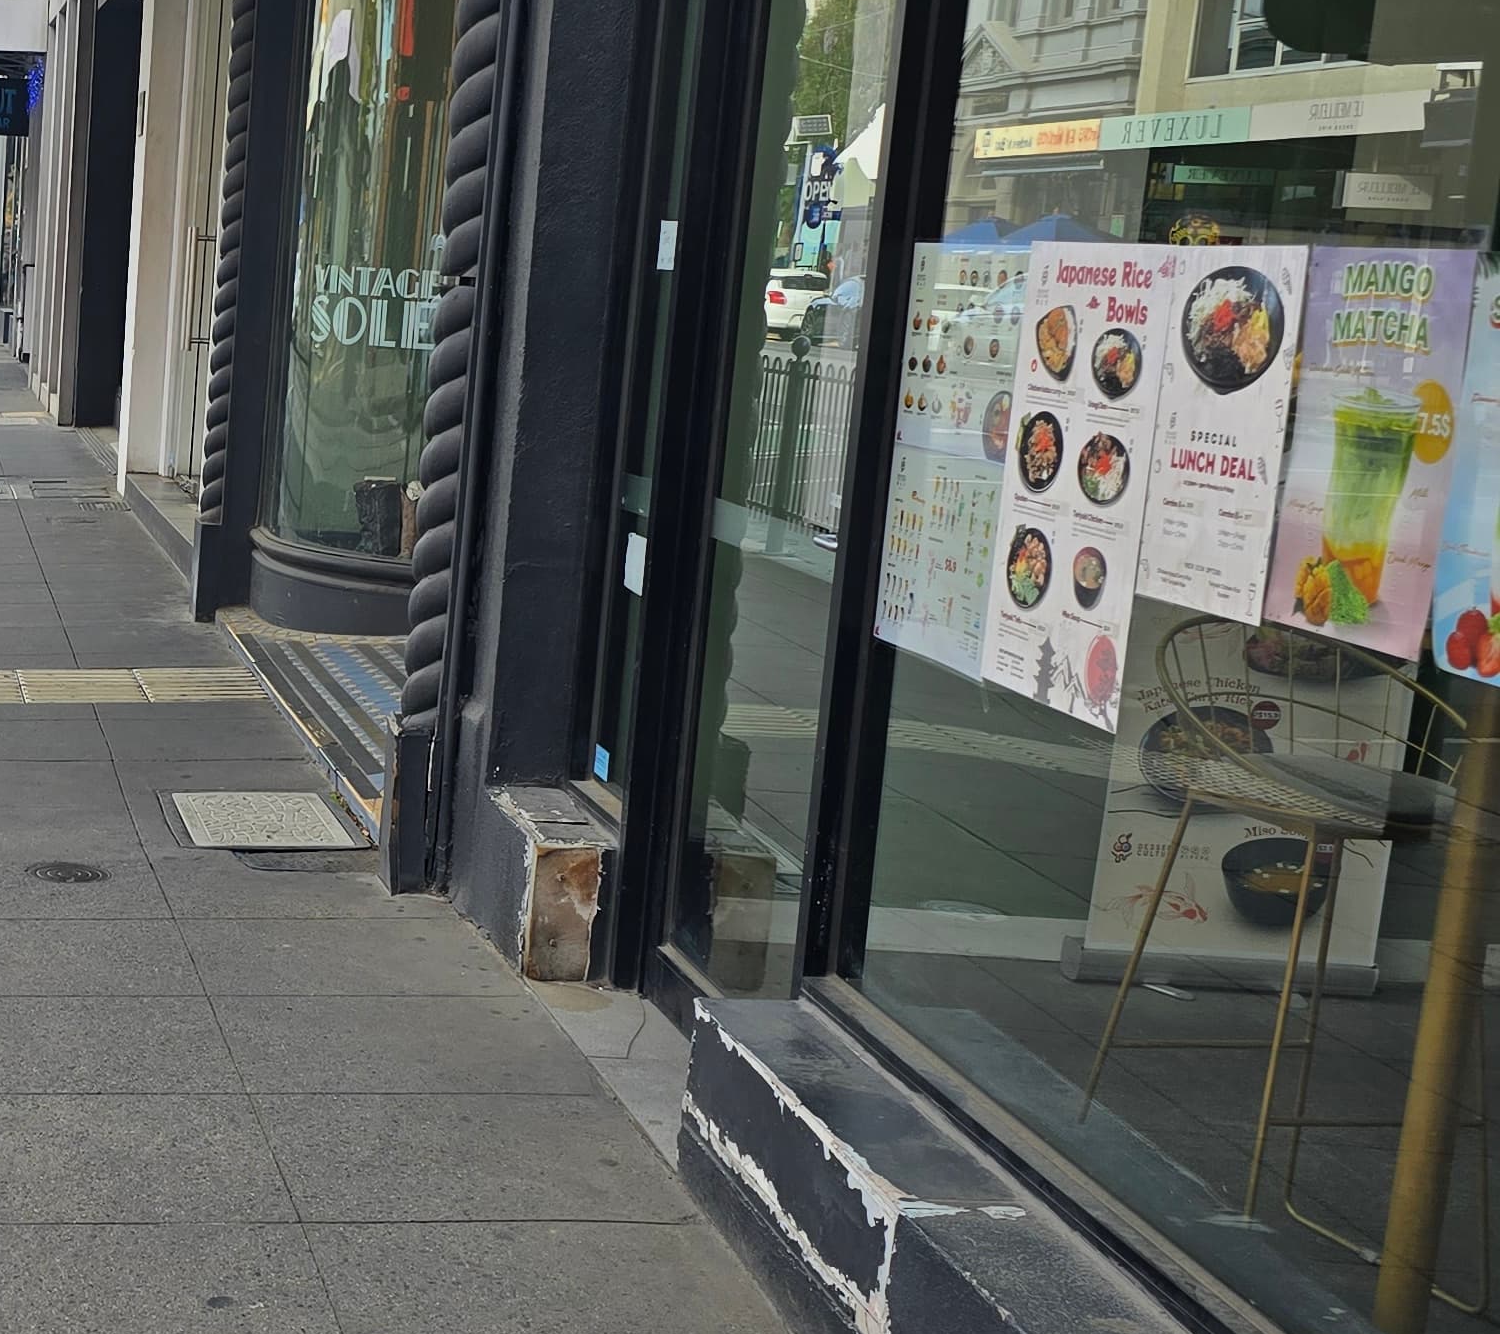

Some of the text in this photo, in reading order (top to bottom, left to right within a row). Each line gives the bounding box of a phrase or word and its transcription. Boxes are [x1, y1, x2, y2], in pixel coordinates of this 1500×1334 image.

[314, 264, 442, 299] VINTAGE
[1056, 259, 1152, 289] Japanese Rice
[1342, 261, 1434, 303] MANGO
[310, 294, 438, 351] SOLE
[1106, 296, 1149, 325] Bowls
[1332, 309, 1431, 356] MATCHA
[1418, 411, 1451, 437] 7.5$
[1190, 430, 1238, 448] SPECIAL
[1170, 447, 1256, 482] LUNCH DEAL
[1137, 677, 1201, 702] Japnese
[1144, 695, 1176, 715] Kats
[1243, 826, 1277, 839] Miso
